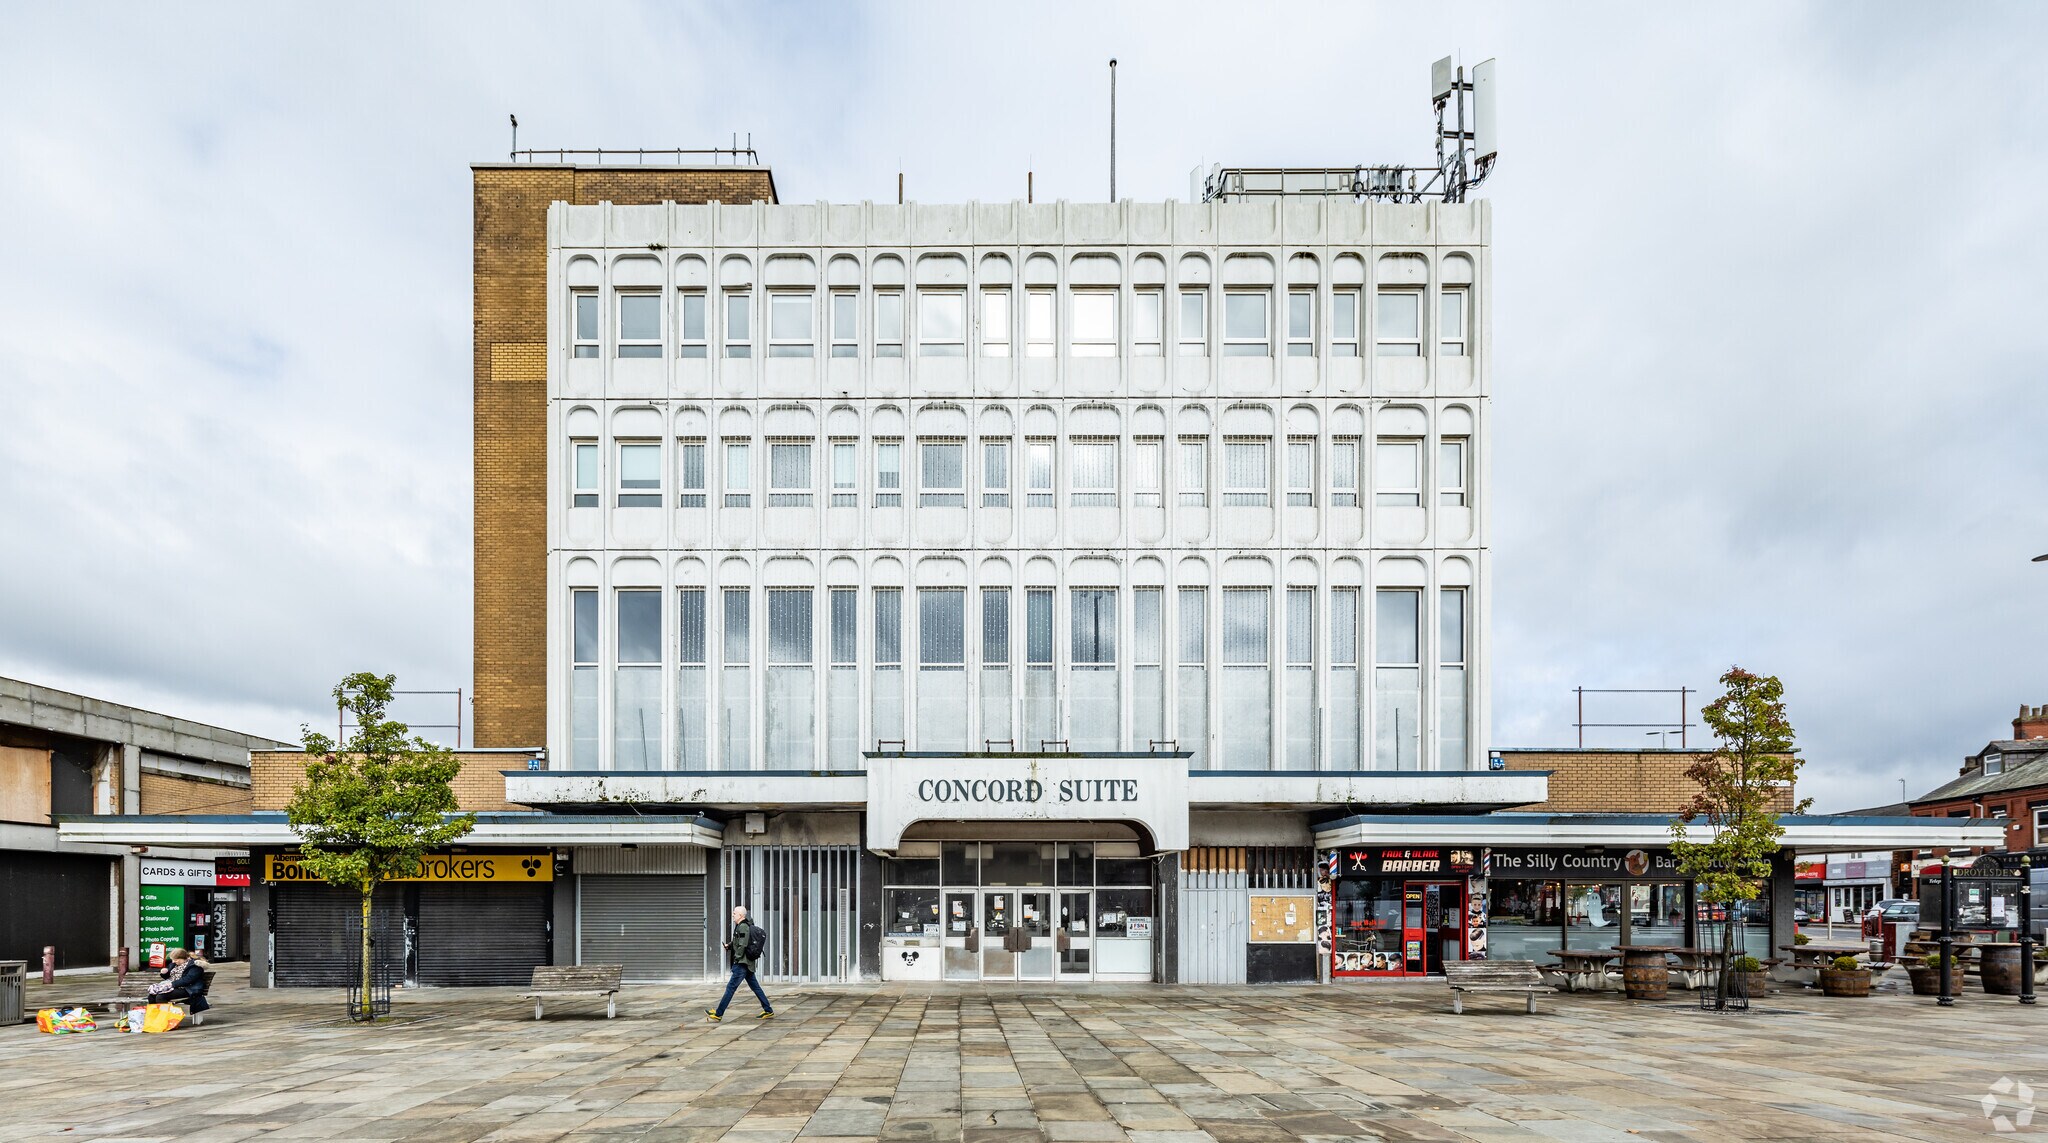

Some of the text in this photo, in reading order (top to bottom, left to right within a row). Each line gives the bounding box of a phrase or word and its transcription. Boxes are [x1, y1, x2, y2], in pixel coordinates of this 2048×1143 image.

[918, 779, 1138, 802] CONCORD SUITE
[273, 854, 305, 862] Albemar
[1382, 850, 1439, 859] FADE & BLADE
[1382, 860, 1440, 872] BARBER
[1493, 854, 1521, 868] The
[1527, 853, 1557, 871] Silly
[1562, 854, 1622, 871] Country
[1656, 856, 1677, 868] Bar
[142, 867, 213, 878] CARDS & GIFTS
[1957, 868, 2016, 877] DROYLSDEN
